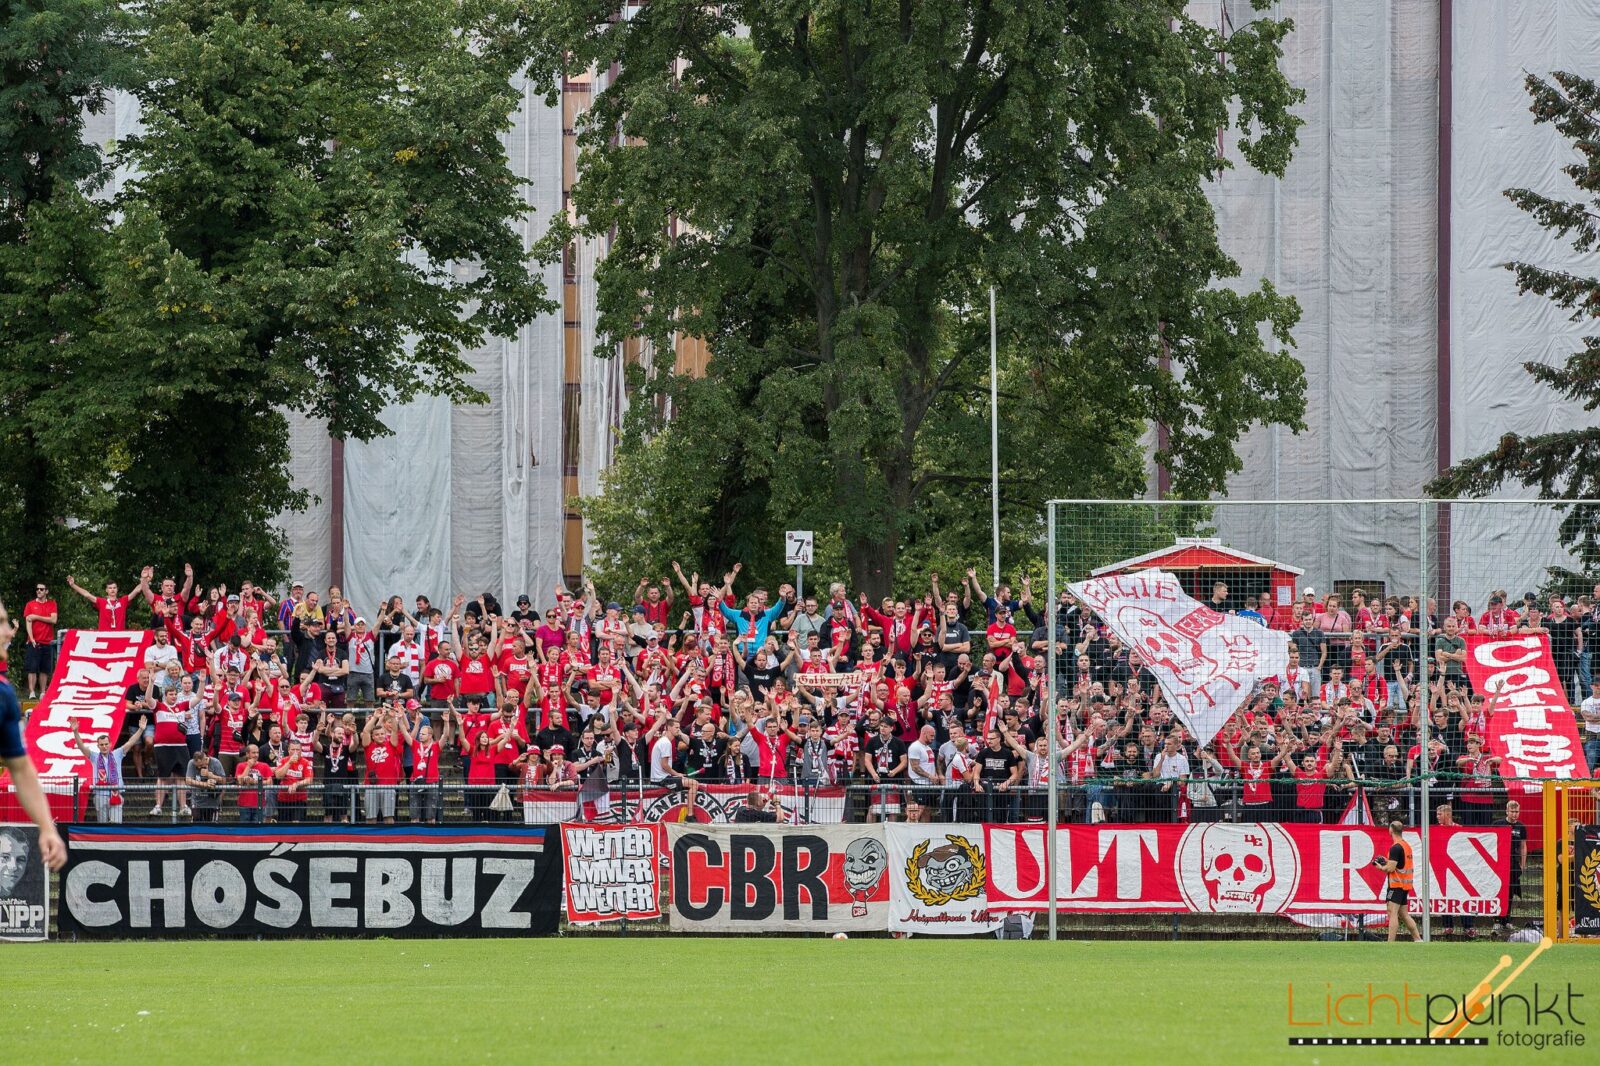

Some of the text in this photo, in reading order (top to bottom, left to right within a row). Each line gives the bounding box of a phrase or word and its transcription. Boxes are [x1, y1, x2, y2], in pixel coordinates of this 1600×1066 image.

[794, 539, 806, 556] 7
[565, 828, 653, 860] WEITER
[66, 842, 535, 929] CHOŚEBUZ
[569, 856, 654, 884] IMMER
[673, 834, 829, 922] CBR
[570, 882, 655, 914] WEITER
